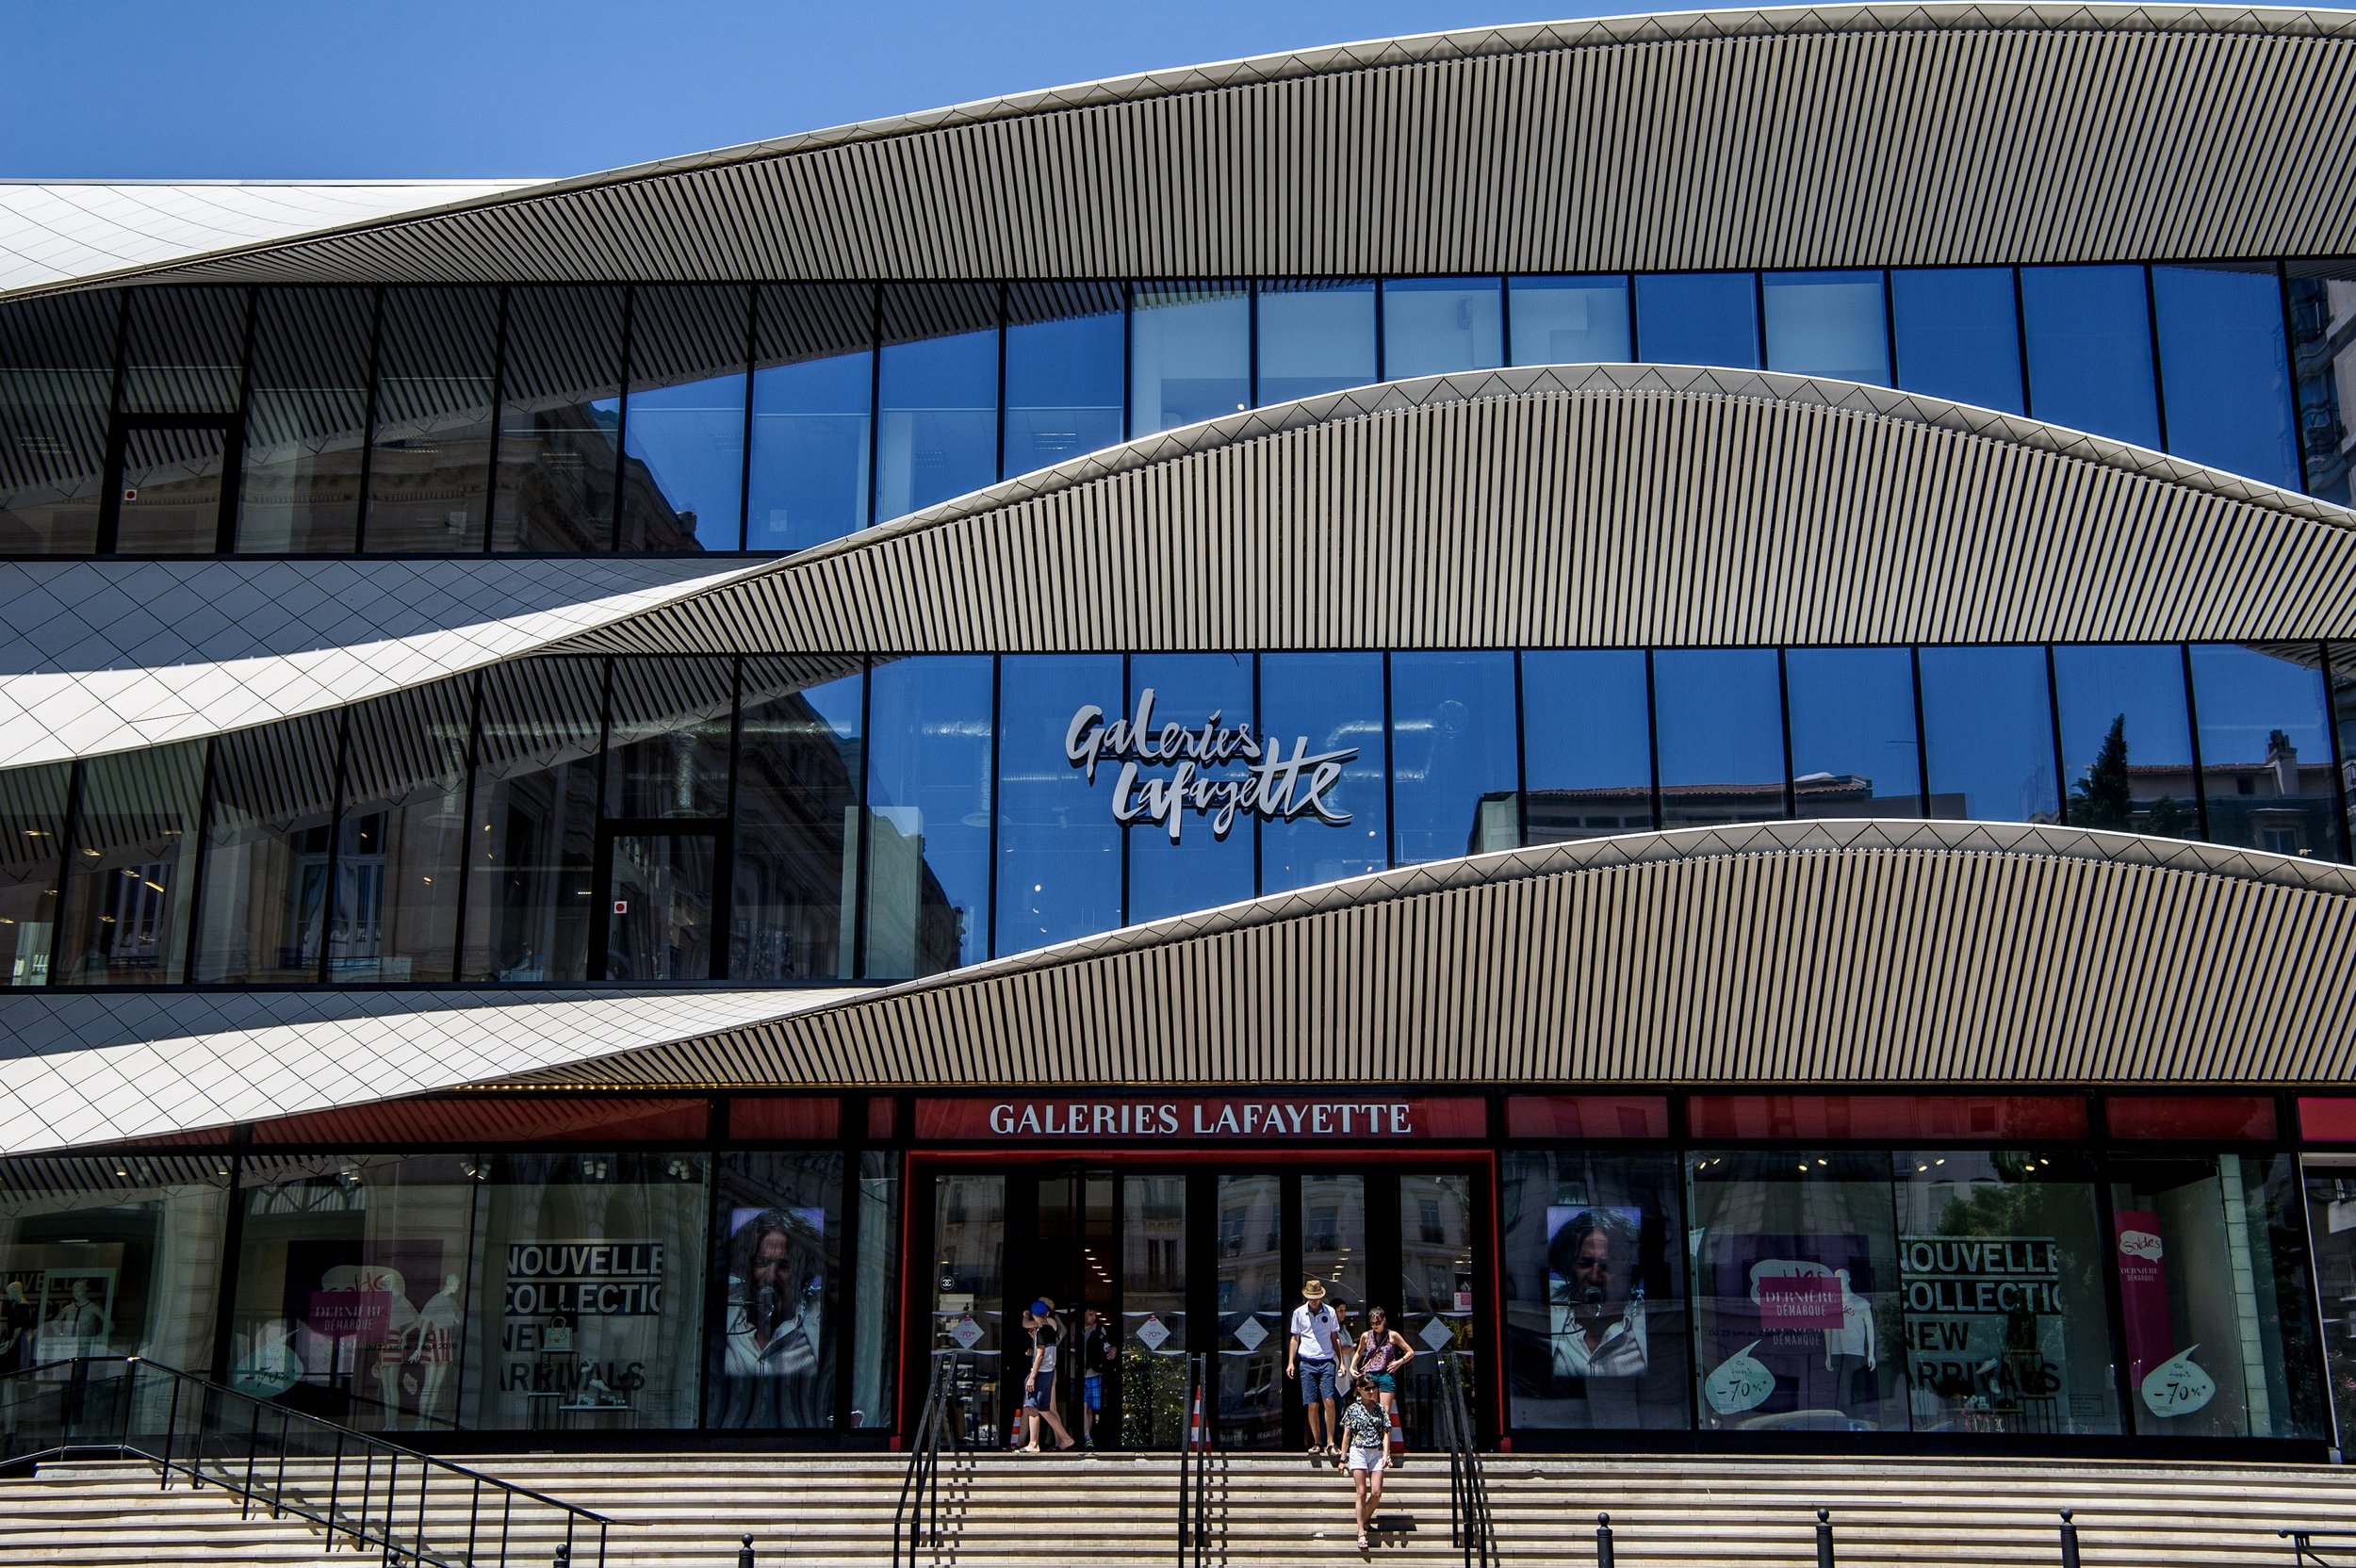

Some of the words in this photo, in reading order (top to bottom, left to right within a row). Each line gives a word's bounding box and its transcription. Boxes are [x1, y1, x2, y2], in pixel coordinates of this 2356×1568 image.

[1065, 688, 1261, 778] Galeries
[1112, 736, 1359, 838] Lafayette
[990, 1103, 1178, 1135] GALERIES
[1193, 1103, 1412, 1135] LAFAYETTE
[2123, 1236, 2161, 1253] Soldes
[1765, 1289, 1839, 1303] DERNIÈRE
[1902, 1282, 2061, 1312] OLLECTI
[316, 1303, 384, 1317] DERNIÈRE
[1776, 1303, 1826, 1316] DÉMARQUE
[324, 1318, 373, 1331] DÉMARQUE
